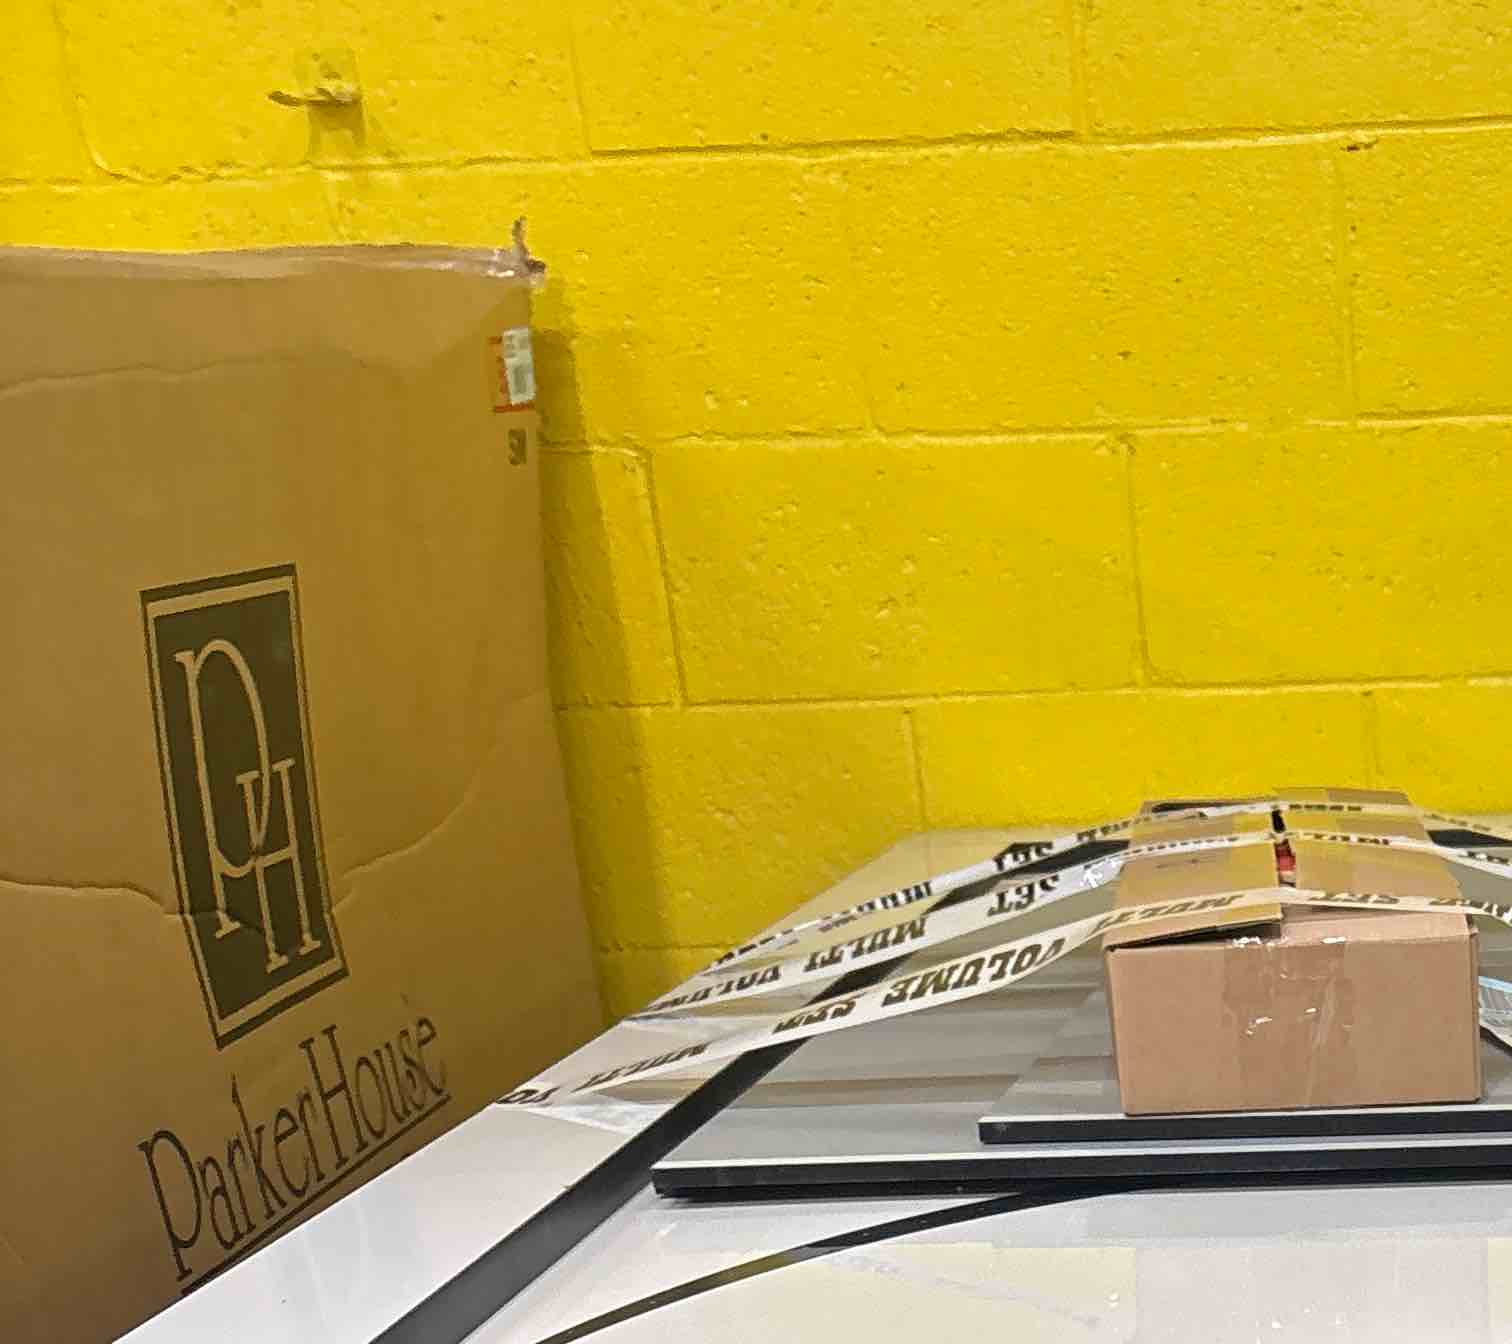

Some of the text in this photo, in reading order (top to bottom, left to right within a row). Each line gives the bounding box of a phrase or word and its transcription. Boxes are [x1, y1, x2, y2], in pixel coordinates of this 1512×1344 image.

[803, 916, 928, 973] MULTI
[880, 937, 1066, 1008] VOLUME
[137, 1016, 443, 1282] ParkerHouse
